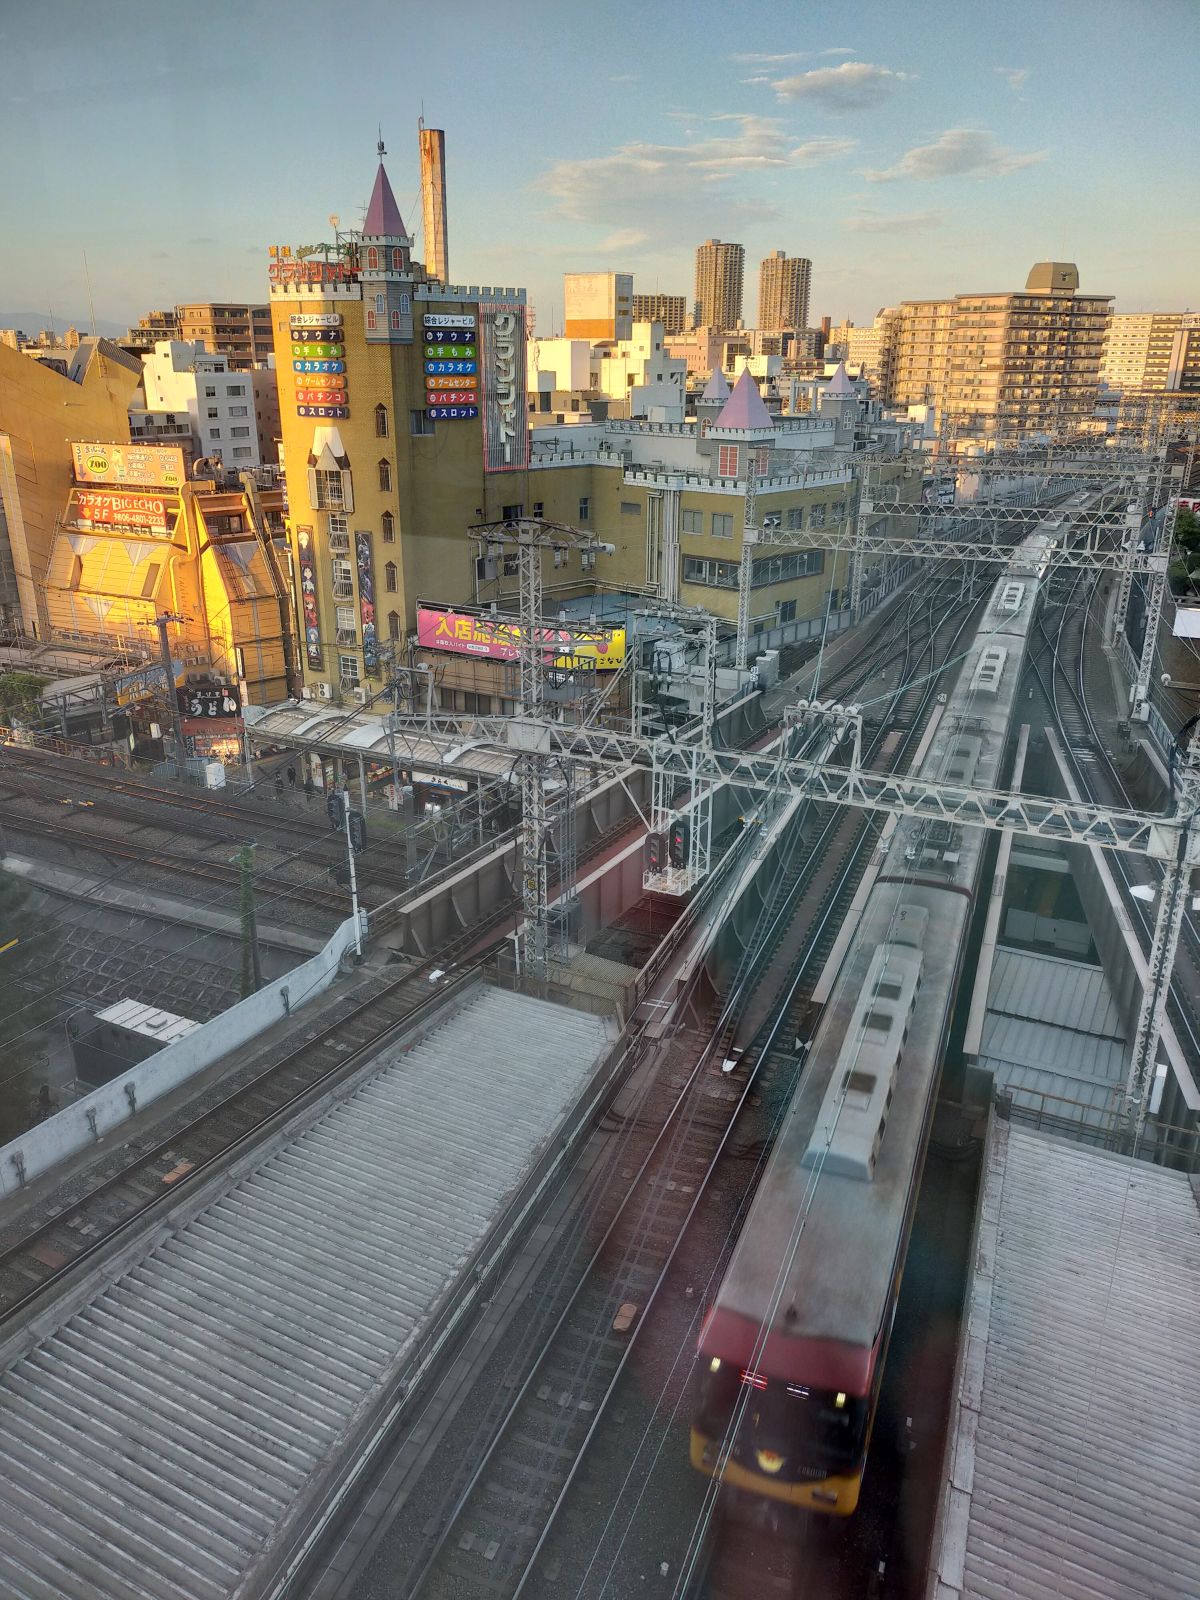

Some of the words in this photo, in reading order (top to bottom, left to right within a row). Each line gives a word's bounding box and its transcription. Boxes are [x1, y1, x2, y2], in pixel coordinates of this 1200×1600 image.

[269, 257, 362, 282] グランシャトー
[301, 330, 337, 340] サウナ
[436, 331, 472, 341] サウナ
[303, 346, 338, 356] 手もみ
[437, 347, 473, 357] 手もみ
[304, 362, 339, 371] カラオケ
[438, 362, 473, 372] カラオケ
[305, 377, 342, 387] ゲームセンター
[438, 377, 476, 387] ゲームセンター
[493, 312, 517, 463] グランシャトー
[307, 393, 341, 401] パチンコ
[439, 393, 475, 402] パチンコ
[308, 407, 342, 416] スロット
[440, 407, 475, 417] スロット
[79, 494, 112, 507] カラオケ
[112, 497, 132, 510] BIG
[133, 498, 164, 514] ECHO
[191, 696, 237, 717] うどん
